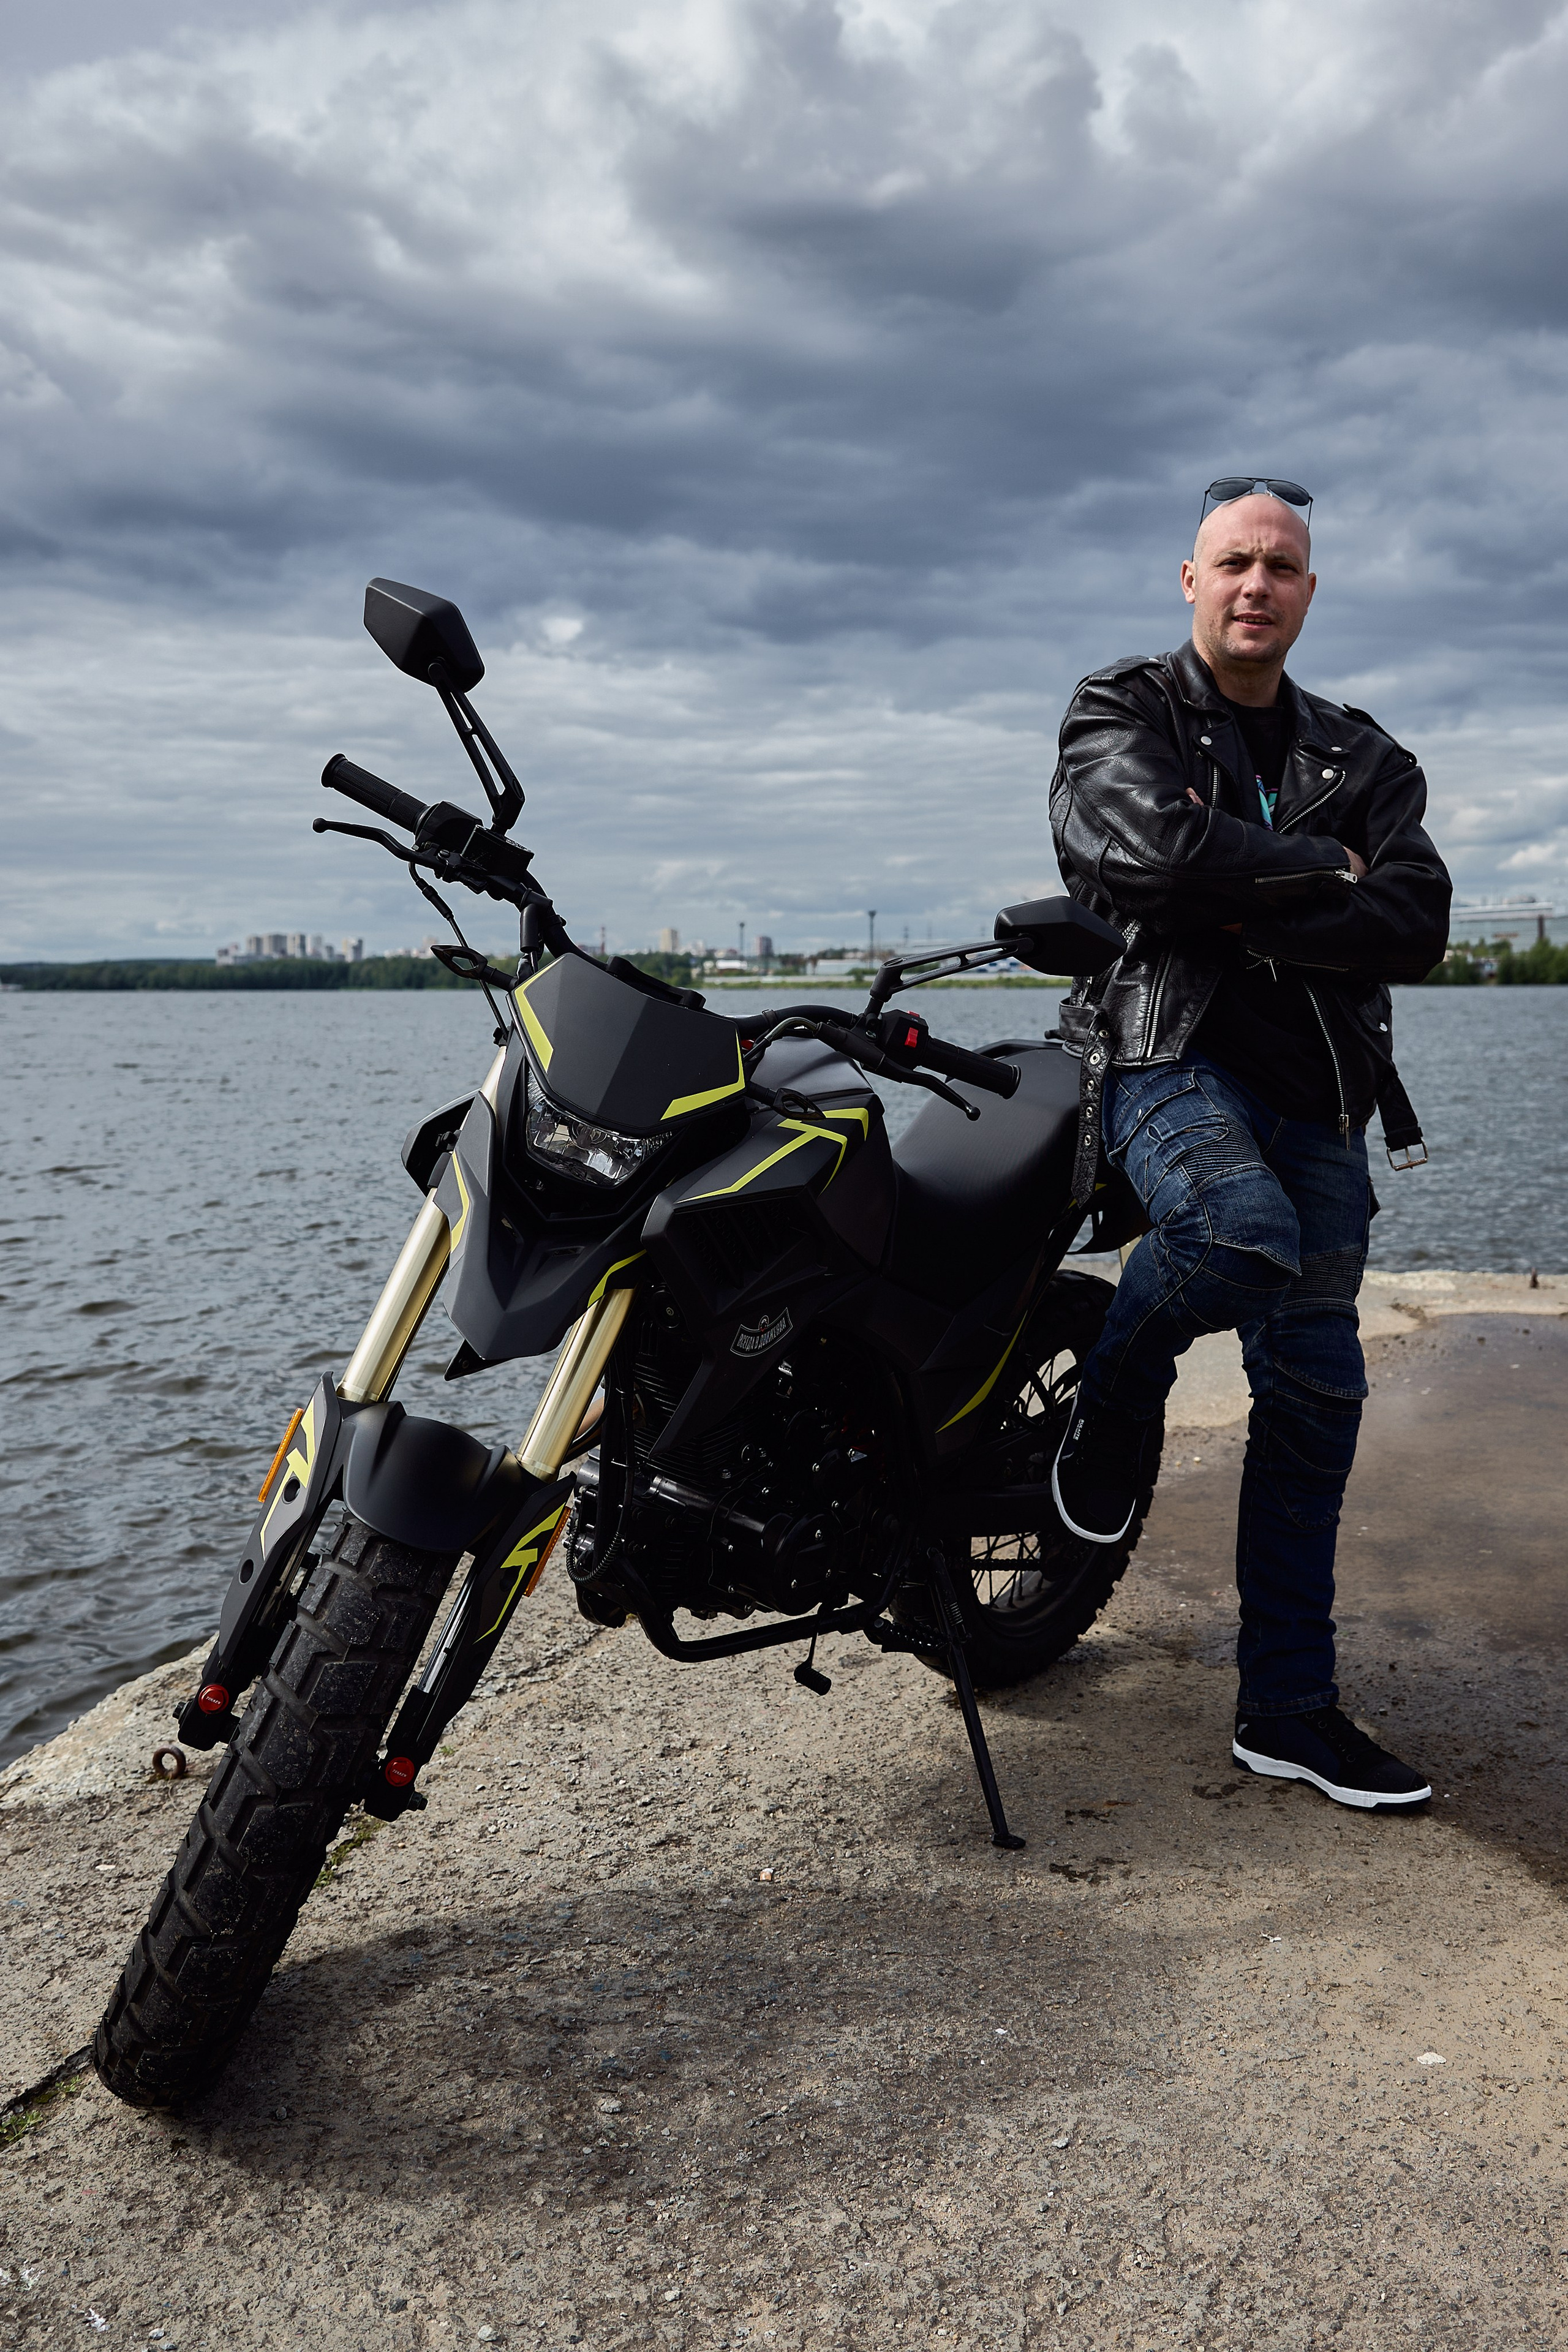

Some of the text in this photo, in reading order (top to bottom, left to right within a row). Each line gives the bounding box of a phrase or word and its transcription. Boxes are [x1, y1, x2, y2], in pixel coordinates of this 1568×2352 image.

[737, 1317, 786, 1351] ВСЕГДА В ДВИЖЕНИИ
